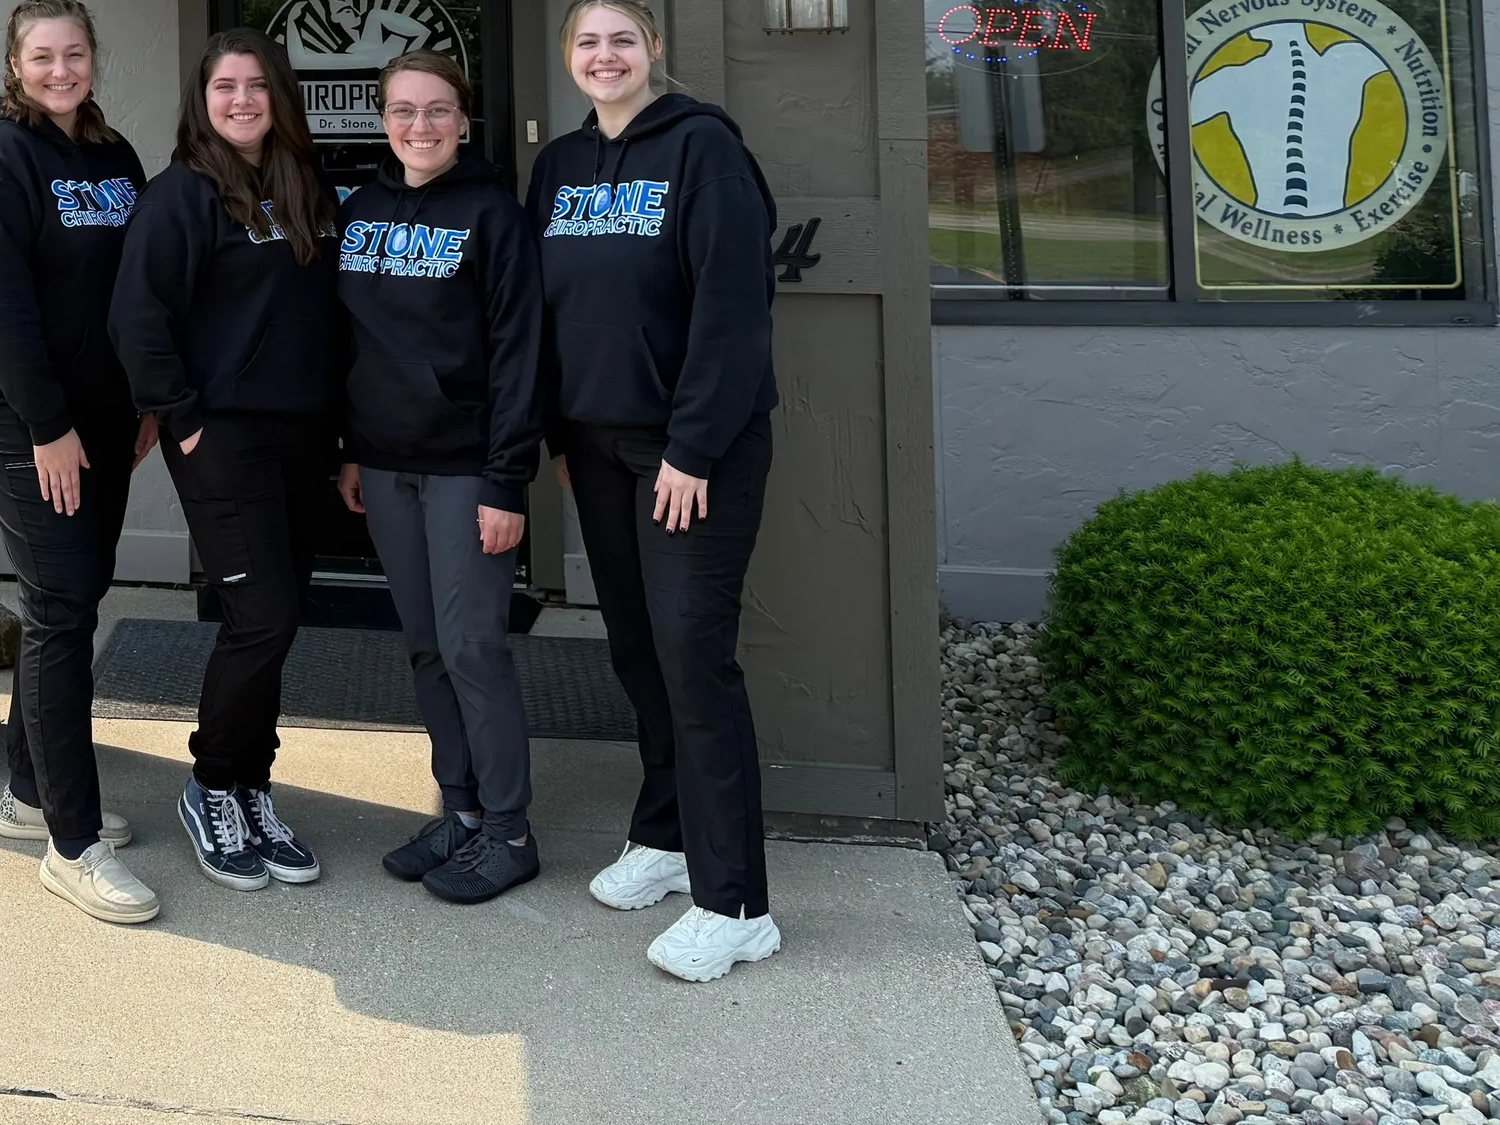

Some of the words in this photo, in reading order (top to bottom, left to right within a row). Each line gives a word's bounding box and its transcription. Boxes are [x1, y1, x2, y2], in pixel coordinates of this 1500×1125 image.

[938, 5, 1098, 51] OPEN
[301, 83, 380, 111] IROPR
[1394, 37, 1444, 137] Nutrition
[319, 118, 336, 129] Dr.
[340, 118, 378, 130] Stone,
[51, 178, 138, 211] STONE
[551, 180, 670, 221] STONE
[1350, 160, 1429, 233] Exercise
[340, 220, 470, 263] STONE
[543, 216, 662, 237] CHIROPRACTIC
[1219, 202, 1324, 245] Wellness
